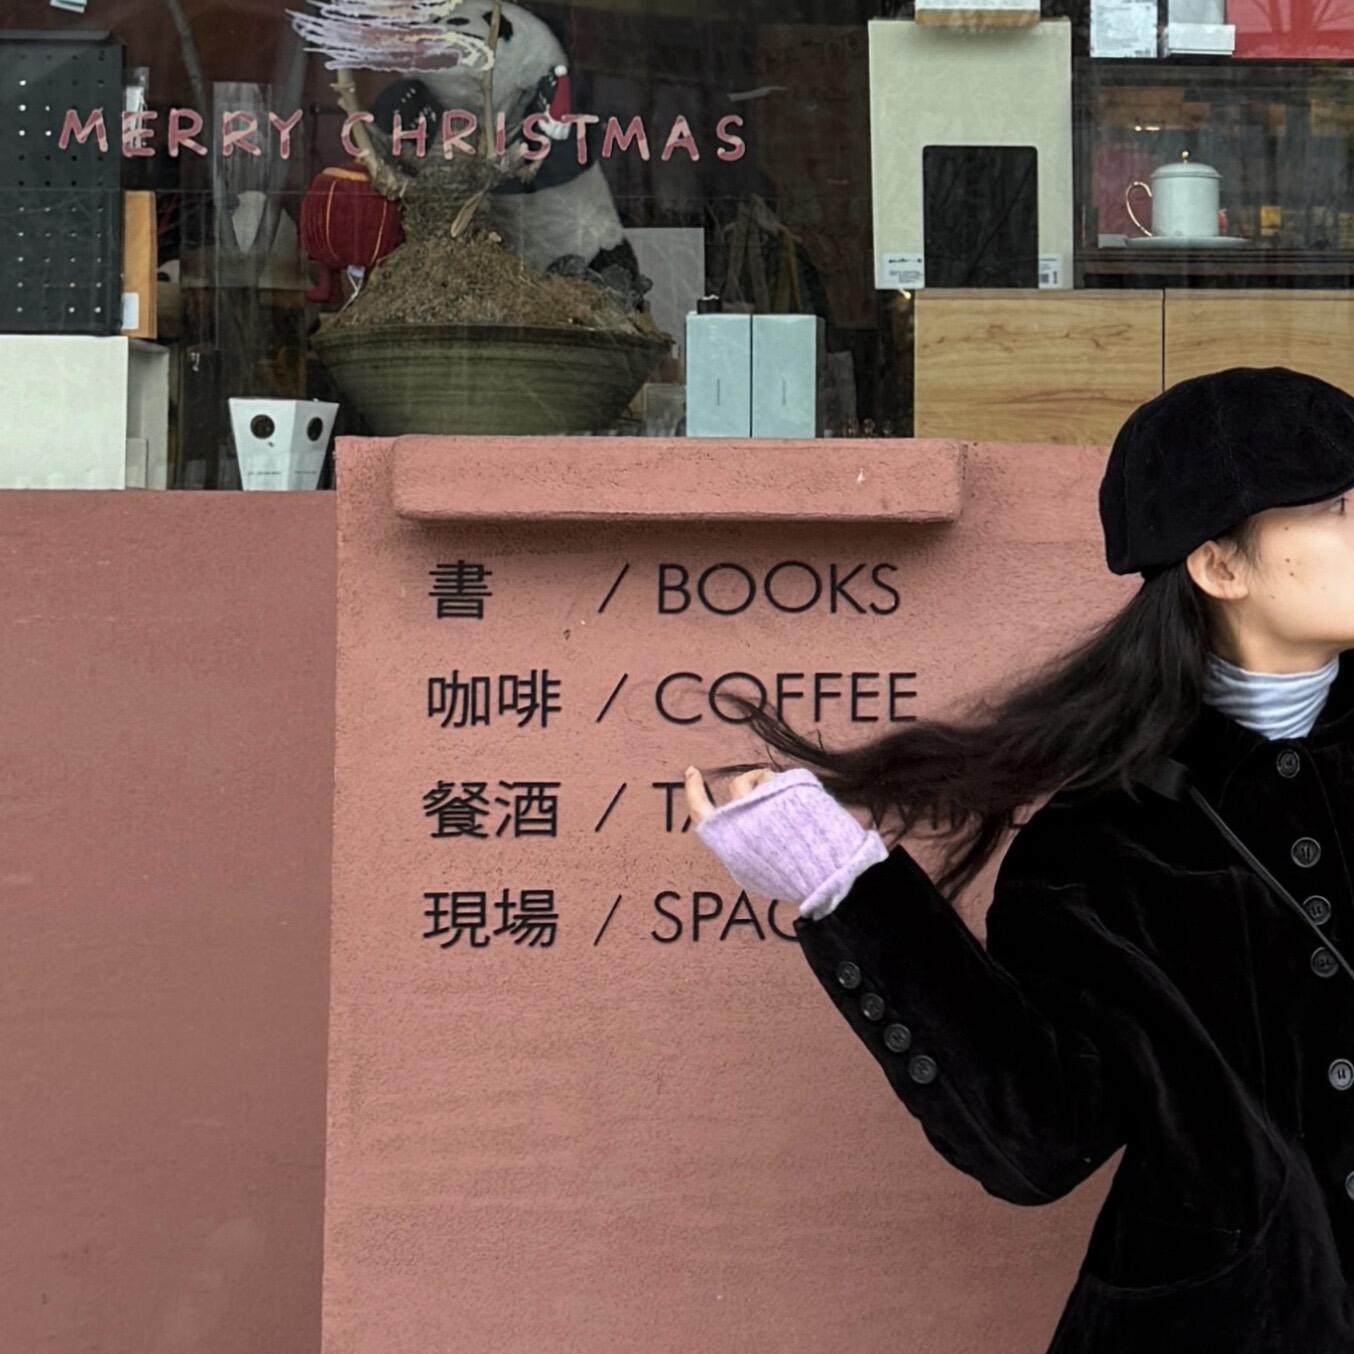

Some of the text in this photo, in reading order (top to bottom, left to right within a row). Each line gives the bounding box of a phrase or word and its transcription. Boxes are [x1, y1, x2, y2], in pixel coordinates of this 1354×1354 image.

[58, 107, 746, 165] MERRY CHRISTMAS
[427, 559, 494, 620] 書
[657, 560, 902, 616] BOOKS
[427, 668, 562, 728] 咖啡
[655, 671, 919, 725] COFFEE
[422, 780, 561, 840] 餐酒
[422, 889, 559, 950] 現場
